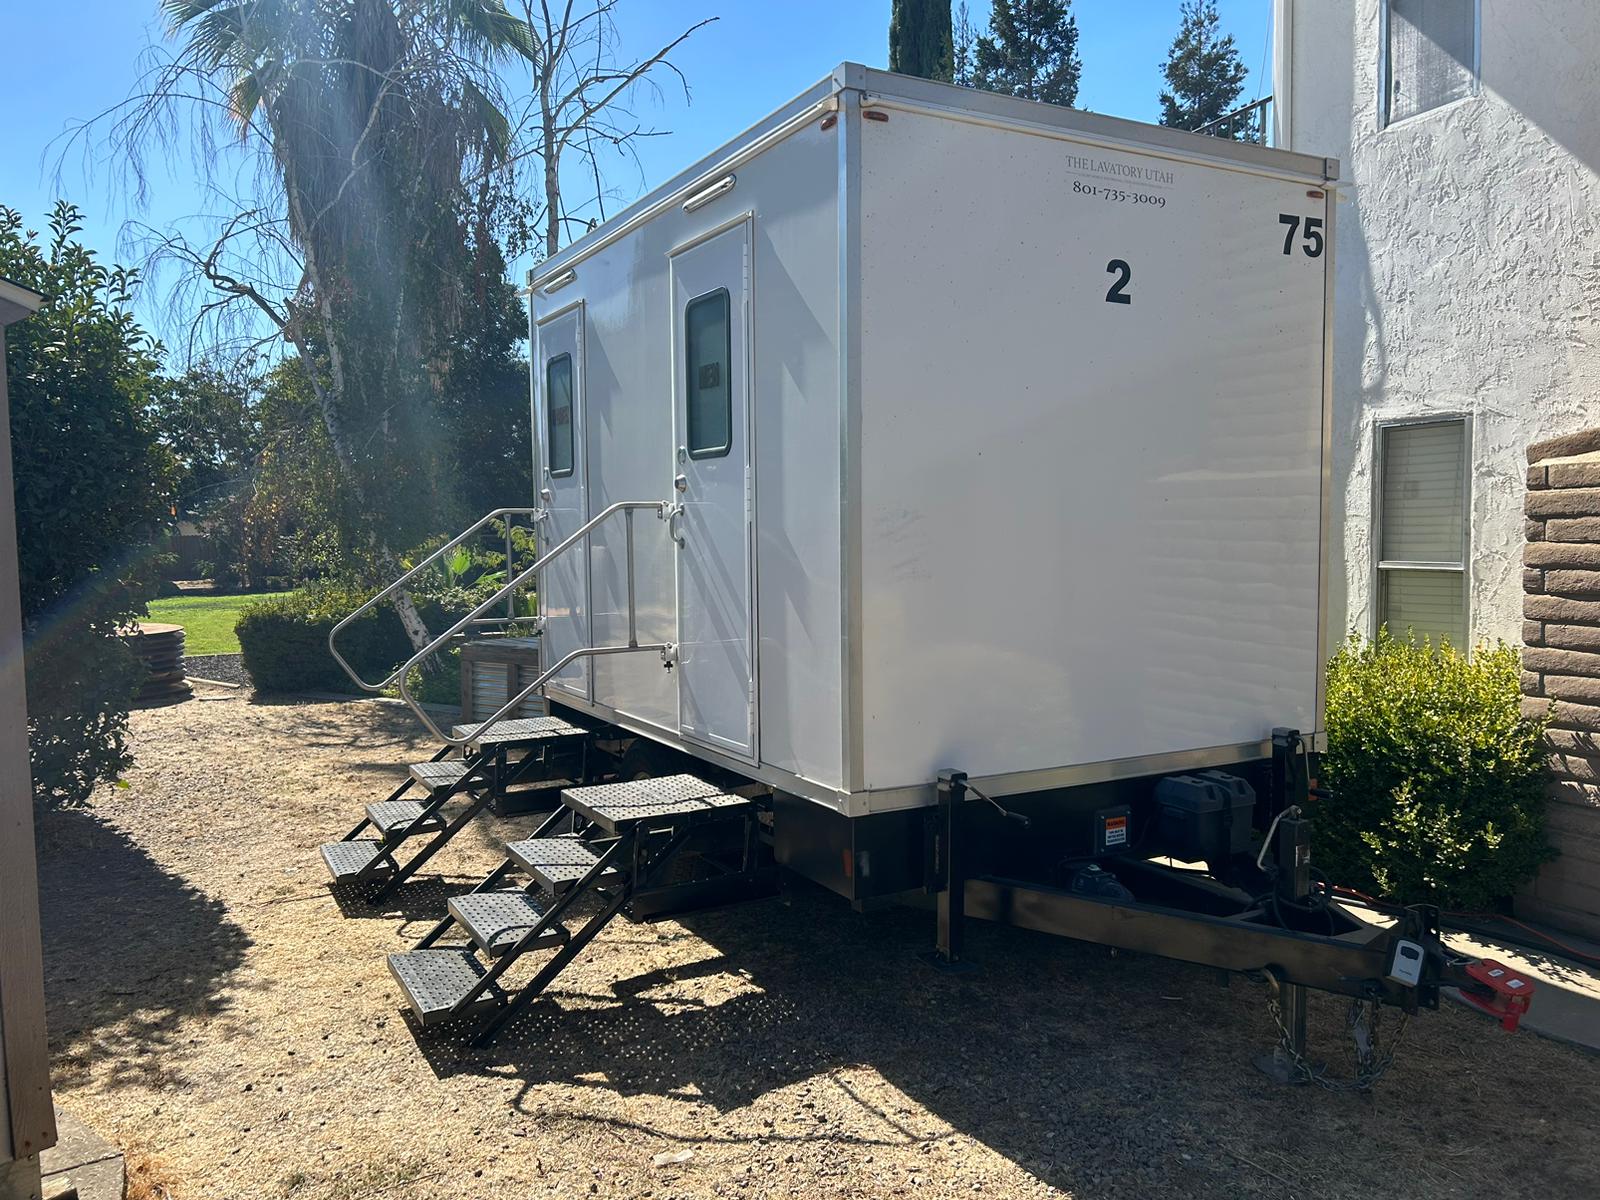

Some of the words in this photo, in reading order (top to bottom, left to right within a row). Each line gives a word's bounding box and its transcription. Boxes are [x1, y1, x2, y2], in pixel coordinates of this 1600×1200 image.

[1065, 155, 1089, 170] THE
[1090, 159, 1144, 179] LAVATORY
[1145, 168, 1174, 184] UTAH
[1073, 180, 1166, 208] 801-735-3009
[1279, 213, 1324, 258] 75
[1105, 258, 1132, 305] 2
